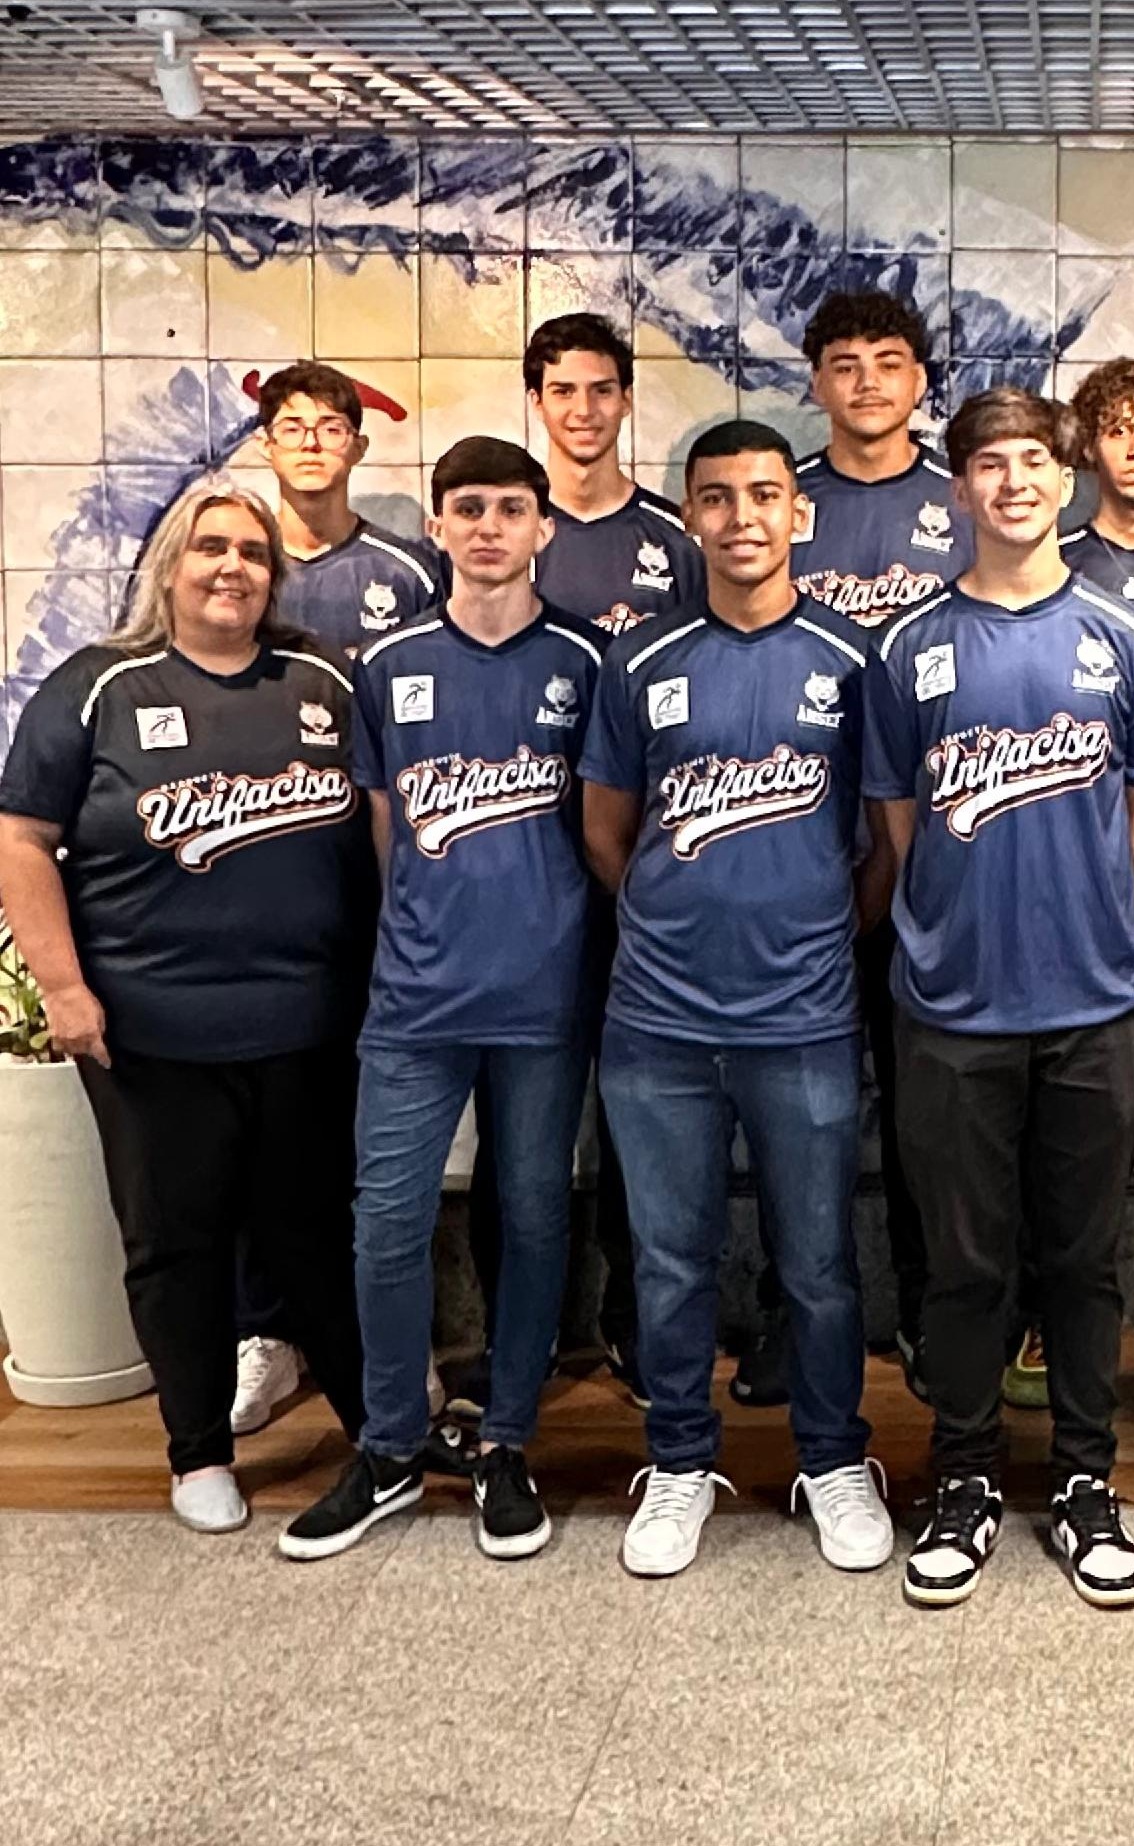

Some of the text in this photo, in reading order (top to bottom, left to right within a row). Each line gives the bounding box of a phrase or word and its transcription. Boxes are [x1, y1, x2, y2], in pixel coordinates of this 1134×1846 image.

[798, 565, 943, 614] ifacisa
[140, 763, 349, 842] Unifacisa
[400, 747, 566, 820] Unifacisa
[660, 746, 827, 822] Unifacisa
